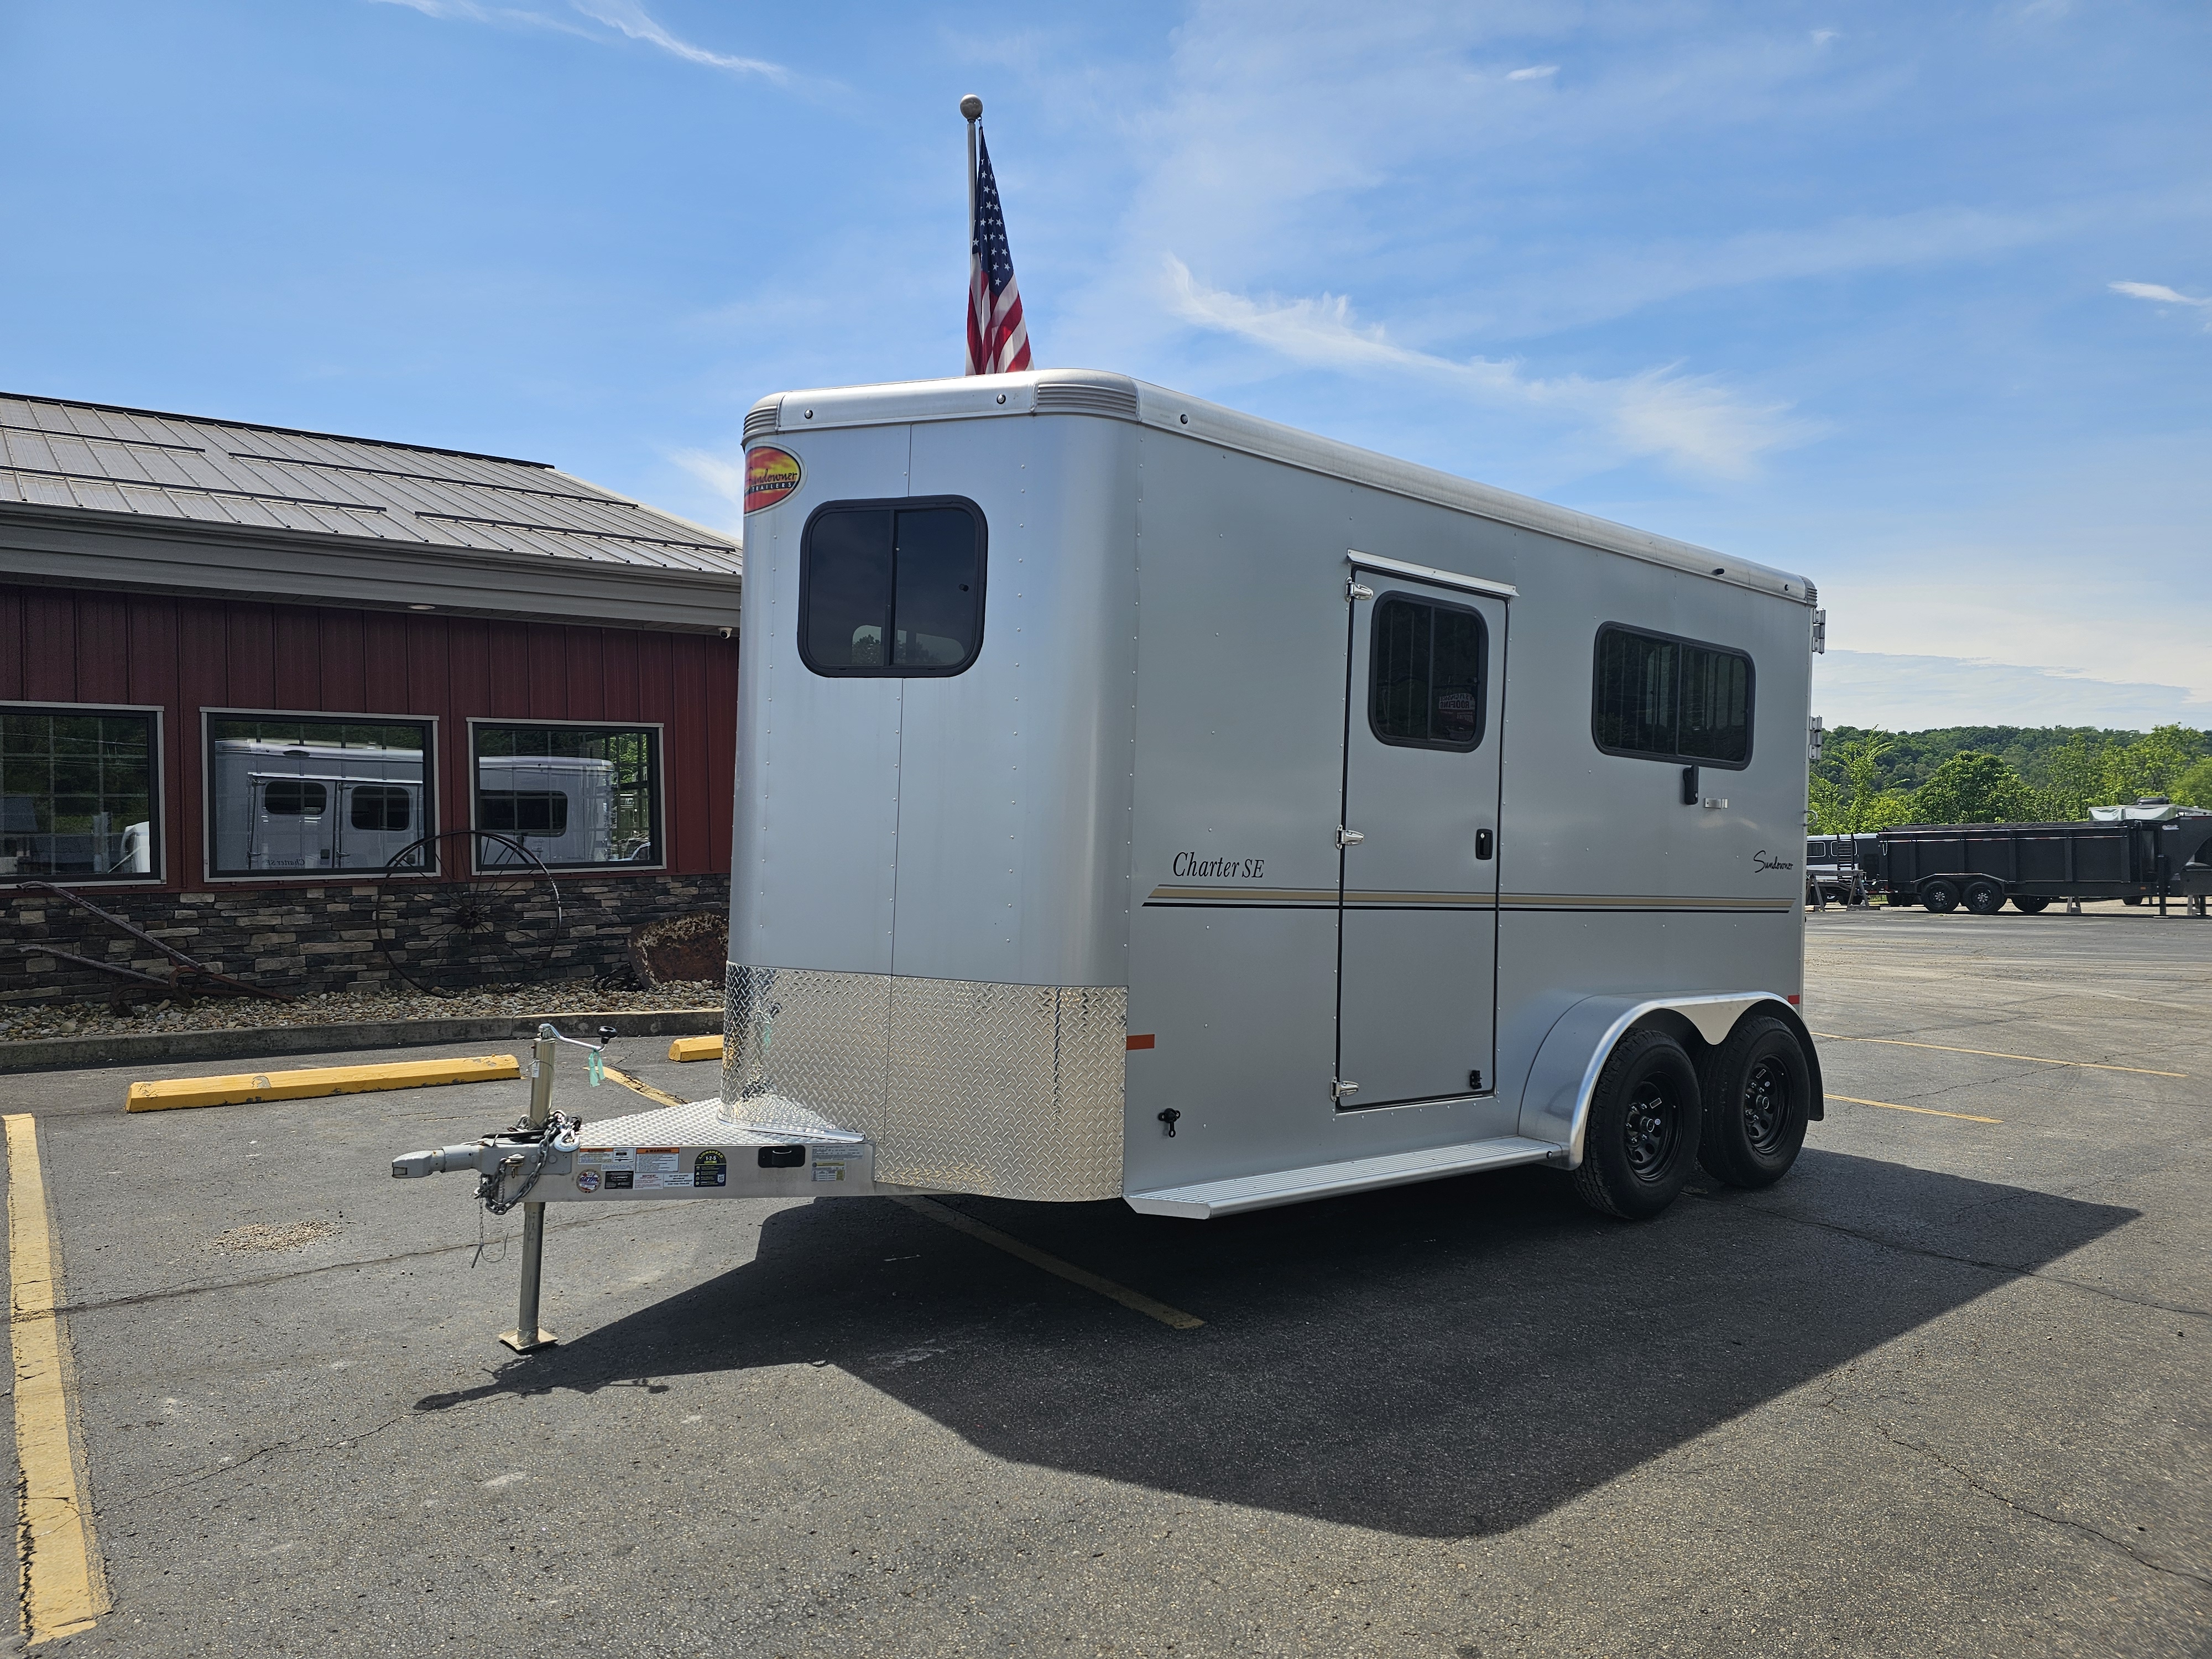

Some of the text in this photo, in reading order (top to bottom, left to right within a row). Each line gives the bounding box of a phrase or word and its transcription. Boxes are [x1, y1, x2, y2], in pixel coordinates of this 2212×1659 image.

[752, 482, 792, 492] TRAILERS
[1173, 852, 1264, 878] Charter SE
[1753, 850, 1793, 873] Sundowner
[698, 1151, 723, 1160] LIONSHEAD
